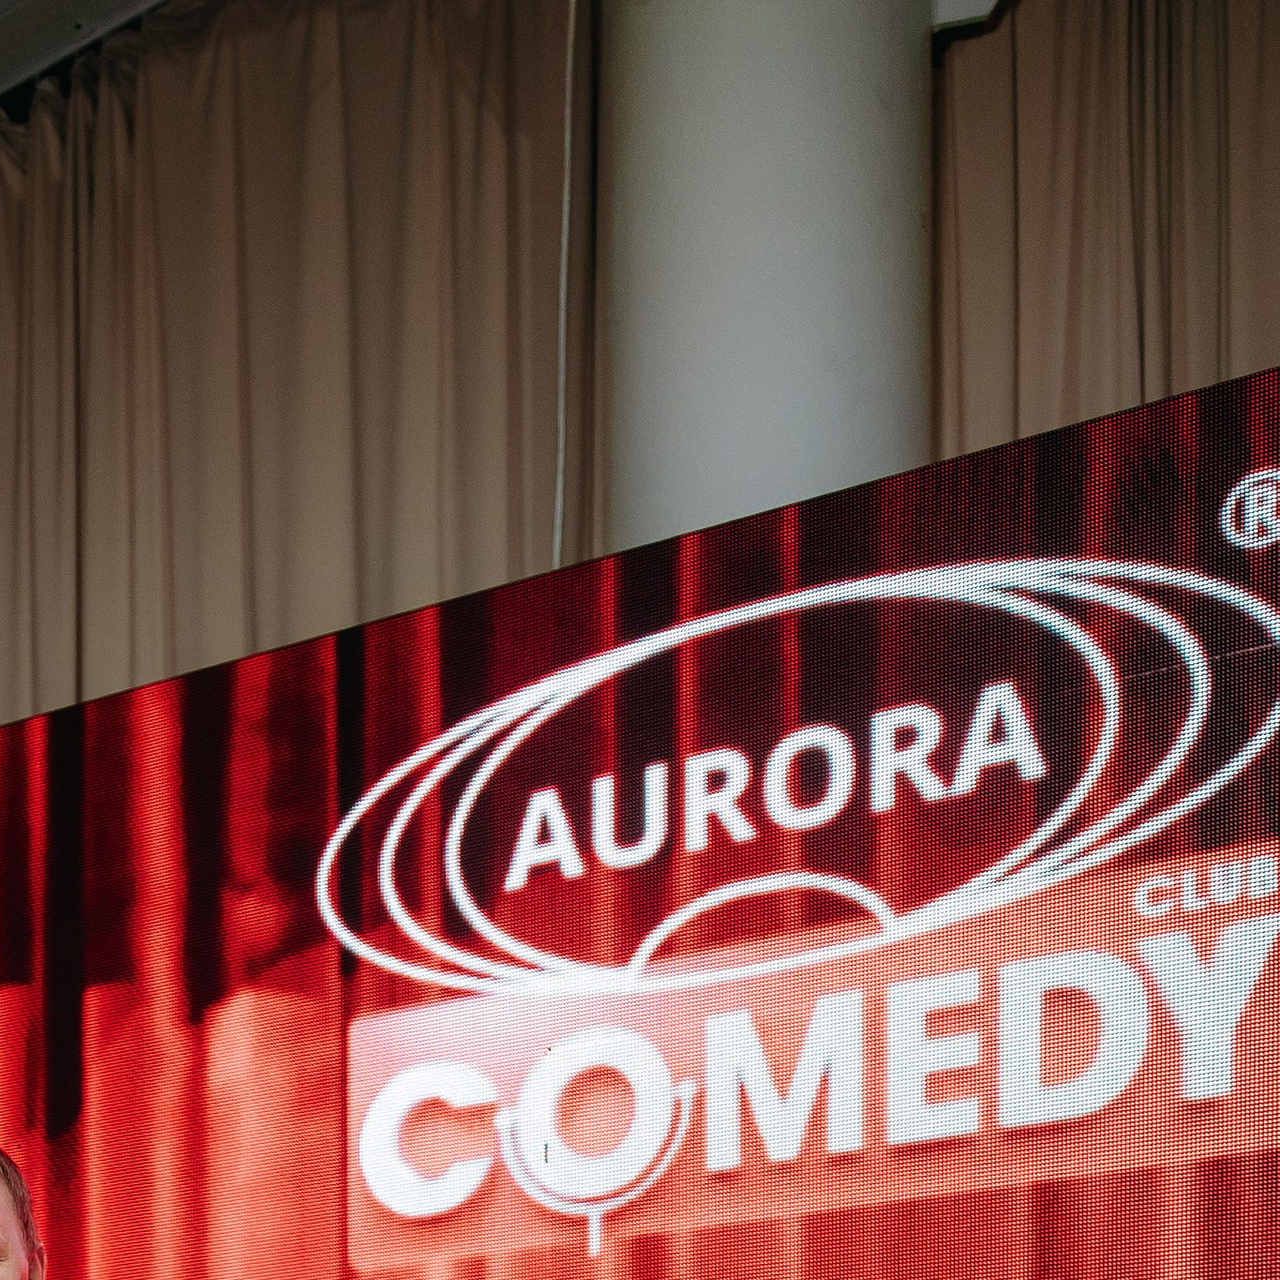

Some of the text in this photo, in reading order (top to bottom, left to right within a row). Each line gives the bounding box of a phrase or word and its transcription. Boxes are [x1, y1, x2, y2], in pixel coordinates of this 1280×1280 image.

[505, 680, 1049, 891] AURORA
[1133, 855, 1279, 917] CLUB
[358, 914, 1280, 1220] COMEDY
